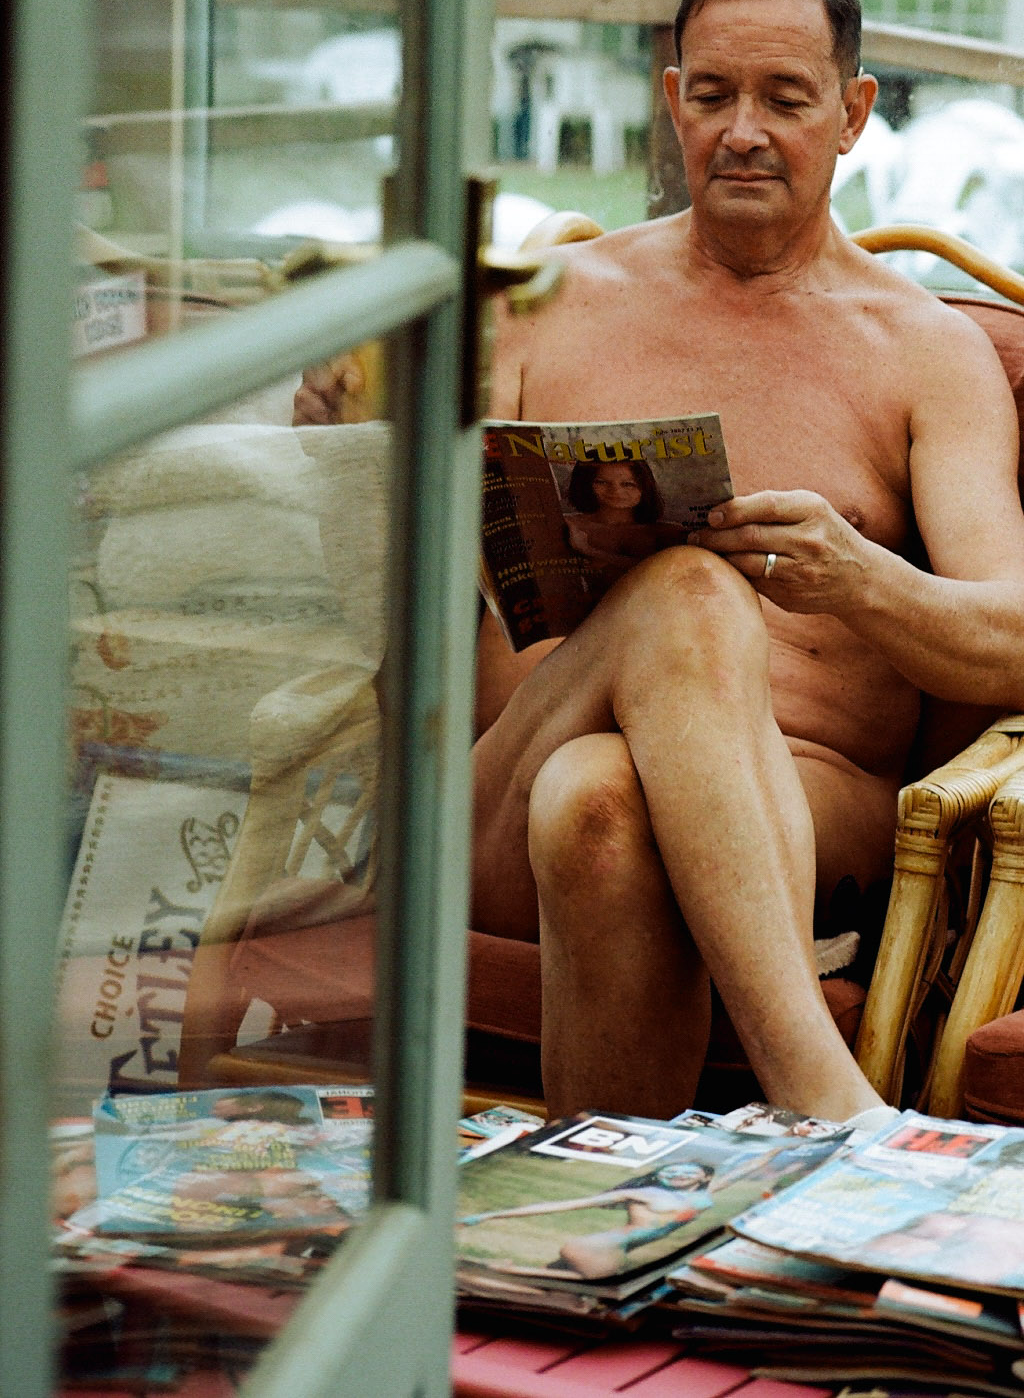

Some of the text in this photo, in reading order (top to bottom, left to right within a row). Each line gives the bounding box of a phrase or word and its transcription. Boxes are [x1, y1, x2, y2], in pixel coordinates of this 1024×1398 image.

[502, 428, 716, 463] Naturist
[90, 933, 136, 1041] CHOICE
[106, 885, 206, 1097] TETLEY
